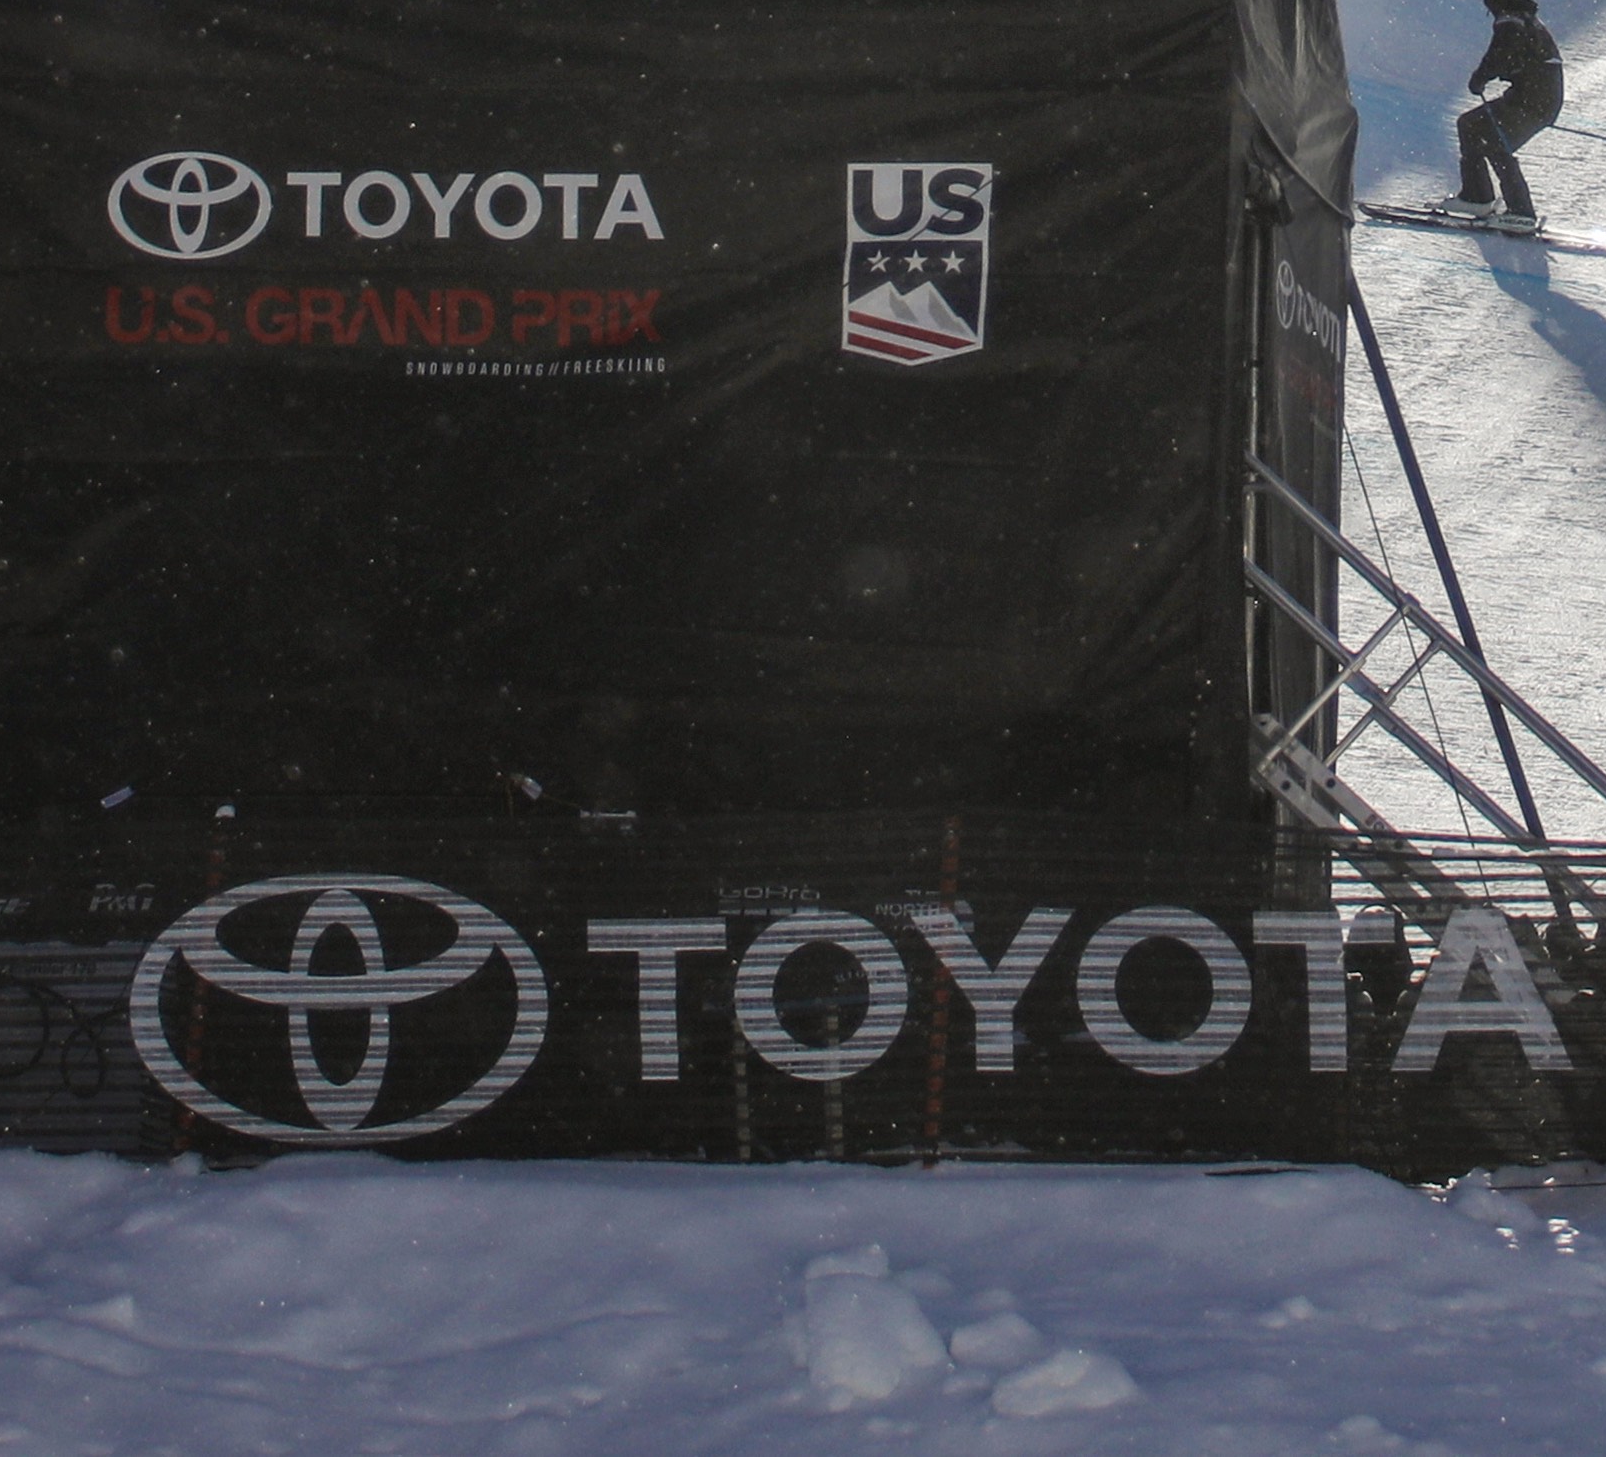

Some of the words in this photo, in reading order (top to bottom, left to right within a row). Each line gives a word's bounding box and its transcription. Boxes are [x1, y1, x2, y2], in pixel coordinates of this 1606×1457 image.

[286, 169, 665, 240] TOYOTA
[852, 168, 985, 237] US
[104, 285, 231, 345] U.S.
[244, 286, 494, 346] GRAND
[511, 288, 662, 347] PRIX
[587, 905, 1573, 1079] TOYOTA
